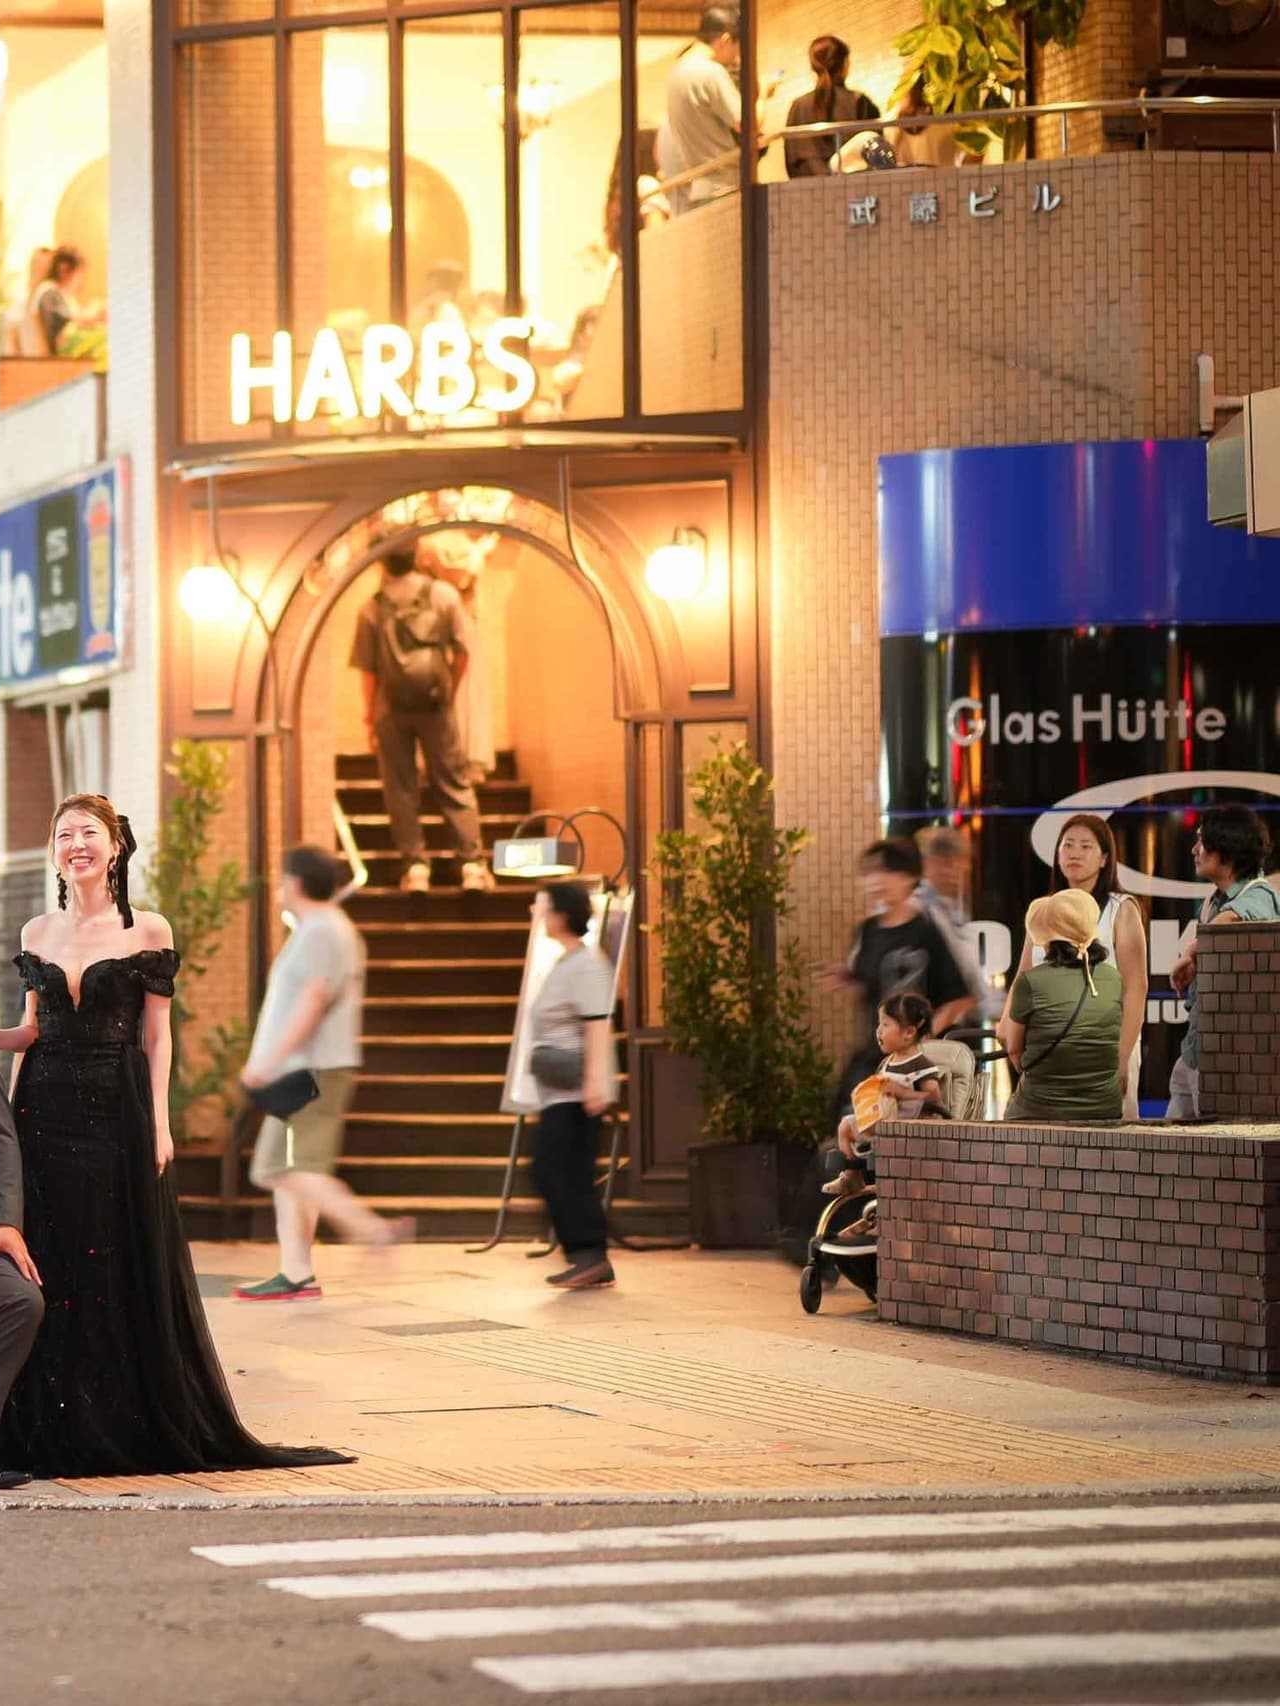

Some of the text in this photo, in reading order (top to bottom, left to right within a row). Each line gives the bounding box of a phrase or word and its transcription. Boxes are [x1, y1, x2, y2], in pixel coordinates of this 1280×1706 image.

[848, 183, 1061, 227] 武藤ビル
[230, 316, 536, 425] HARBS
